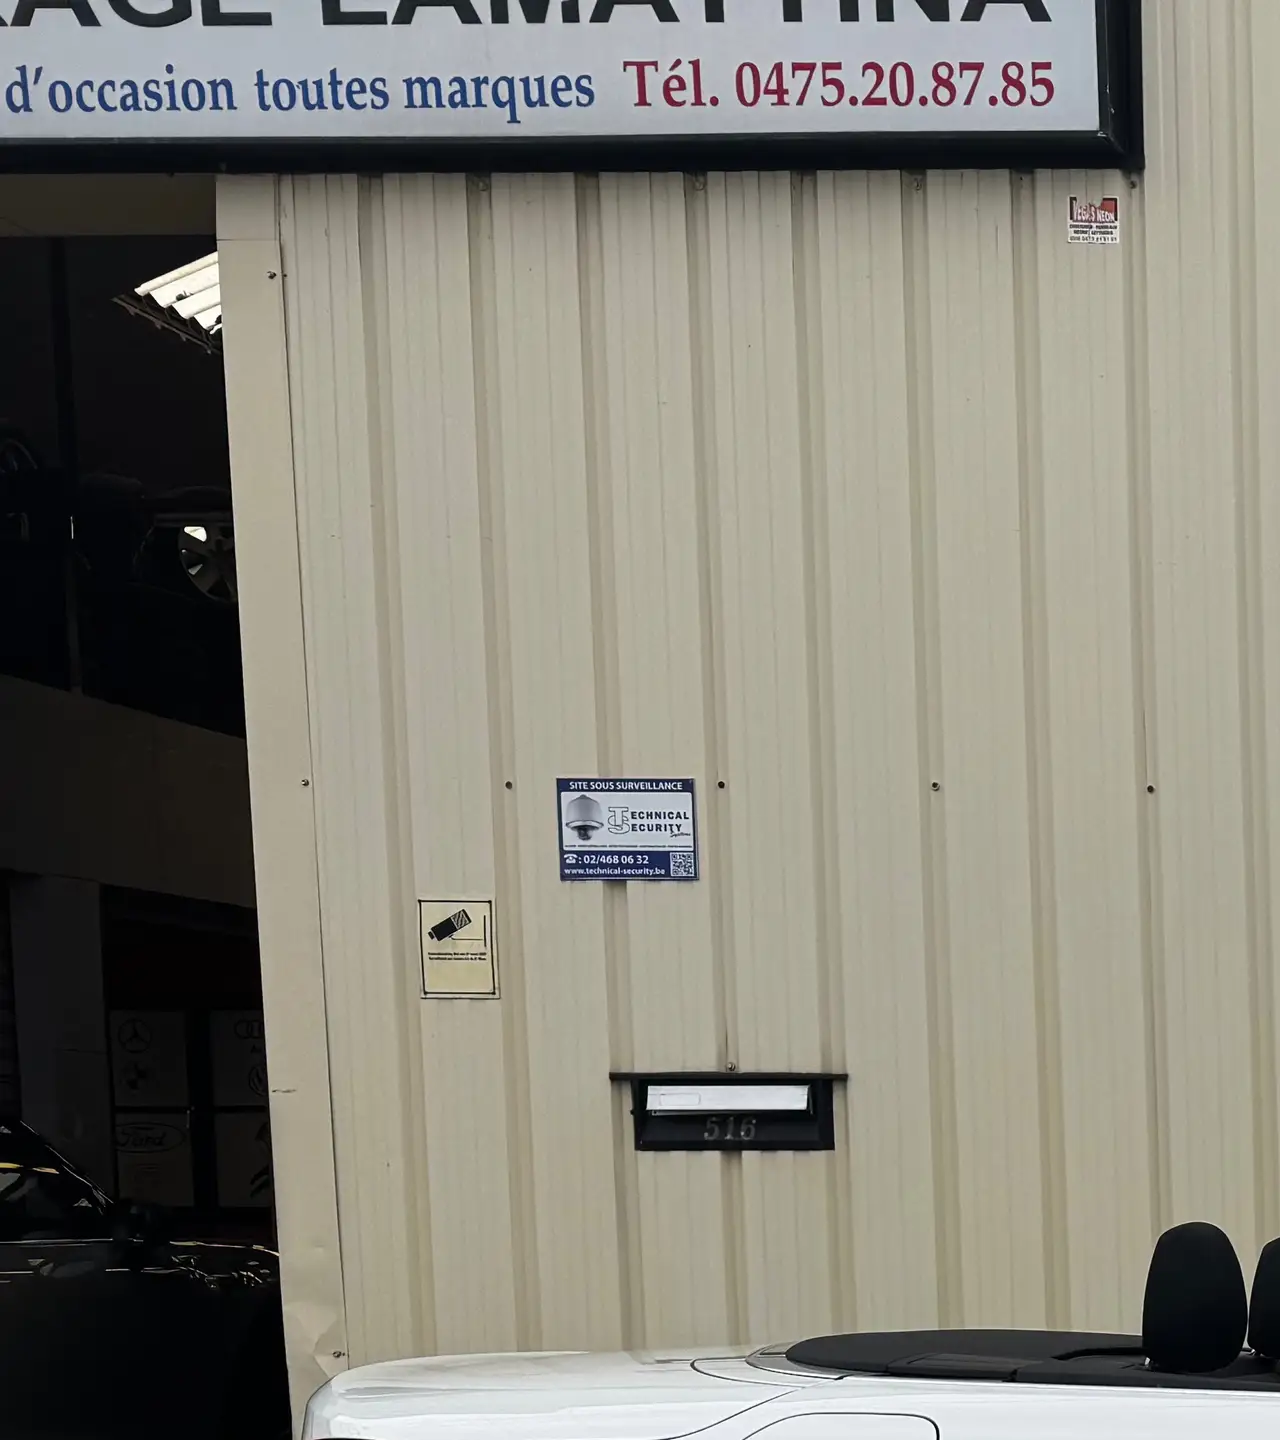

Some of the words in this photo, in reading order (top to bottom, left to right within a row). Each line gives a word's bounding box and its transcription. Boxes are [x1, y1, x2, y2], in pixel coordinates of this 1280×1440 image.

[254, 67, 390, 111] toutes
[403, 74, 595, 124] marques
[623, 57, 720, 107] Tél.
[736, 61, 1055, 108] 0475.20.87.85
[569, 782, 588, 790] SITE
[590, 782, 614, 790] SOUS
[616, 782, 683, 790] SURVEILLANCE
[583, 855, 619, 865] 02/468
[621, 855, 634, 865] 06
[636, 855, 649, 865] 32
[564, 867, 666, 876] www.technical-security.be
[703, 1116, 757, 1140] 516
